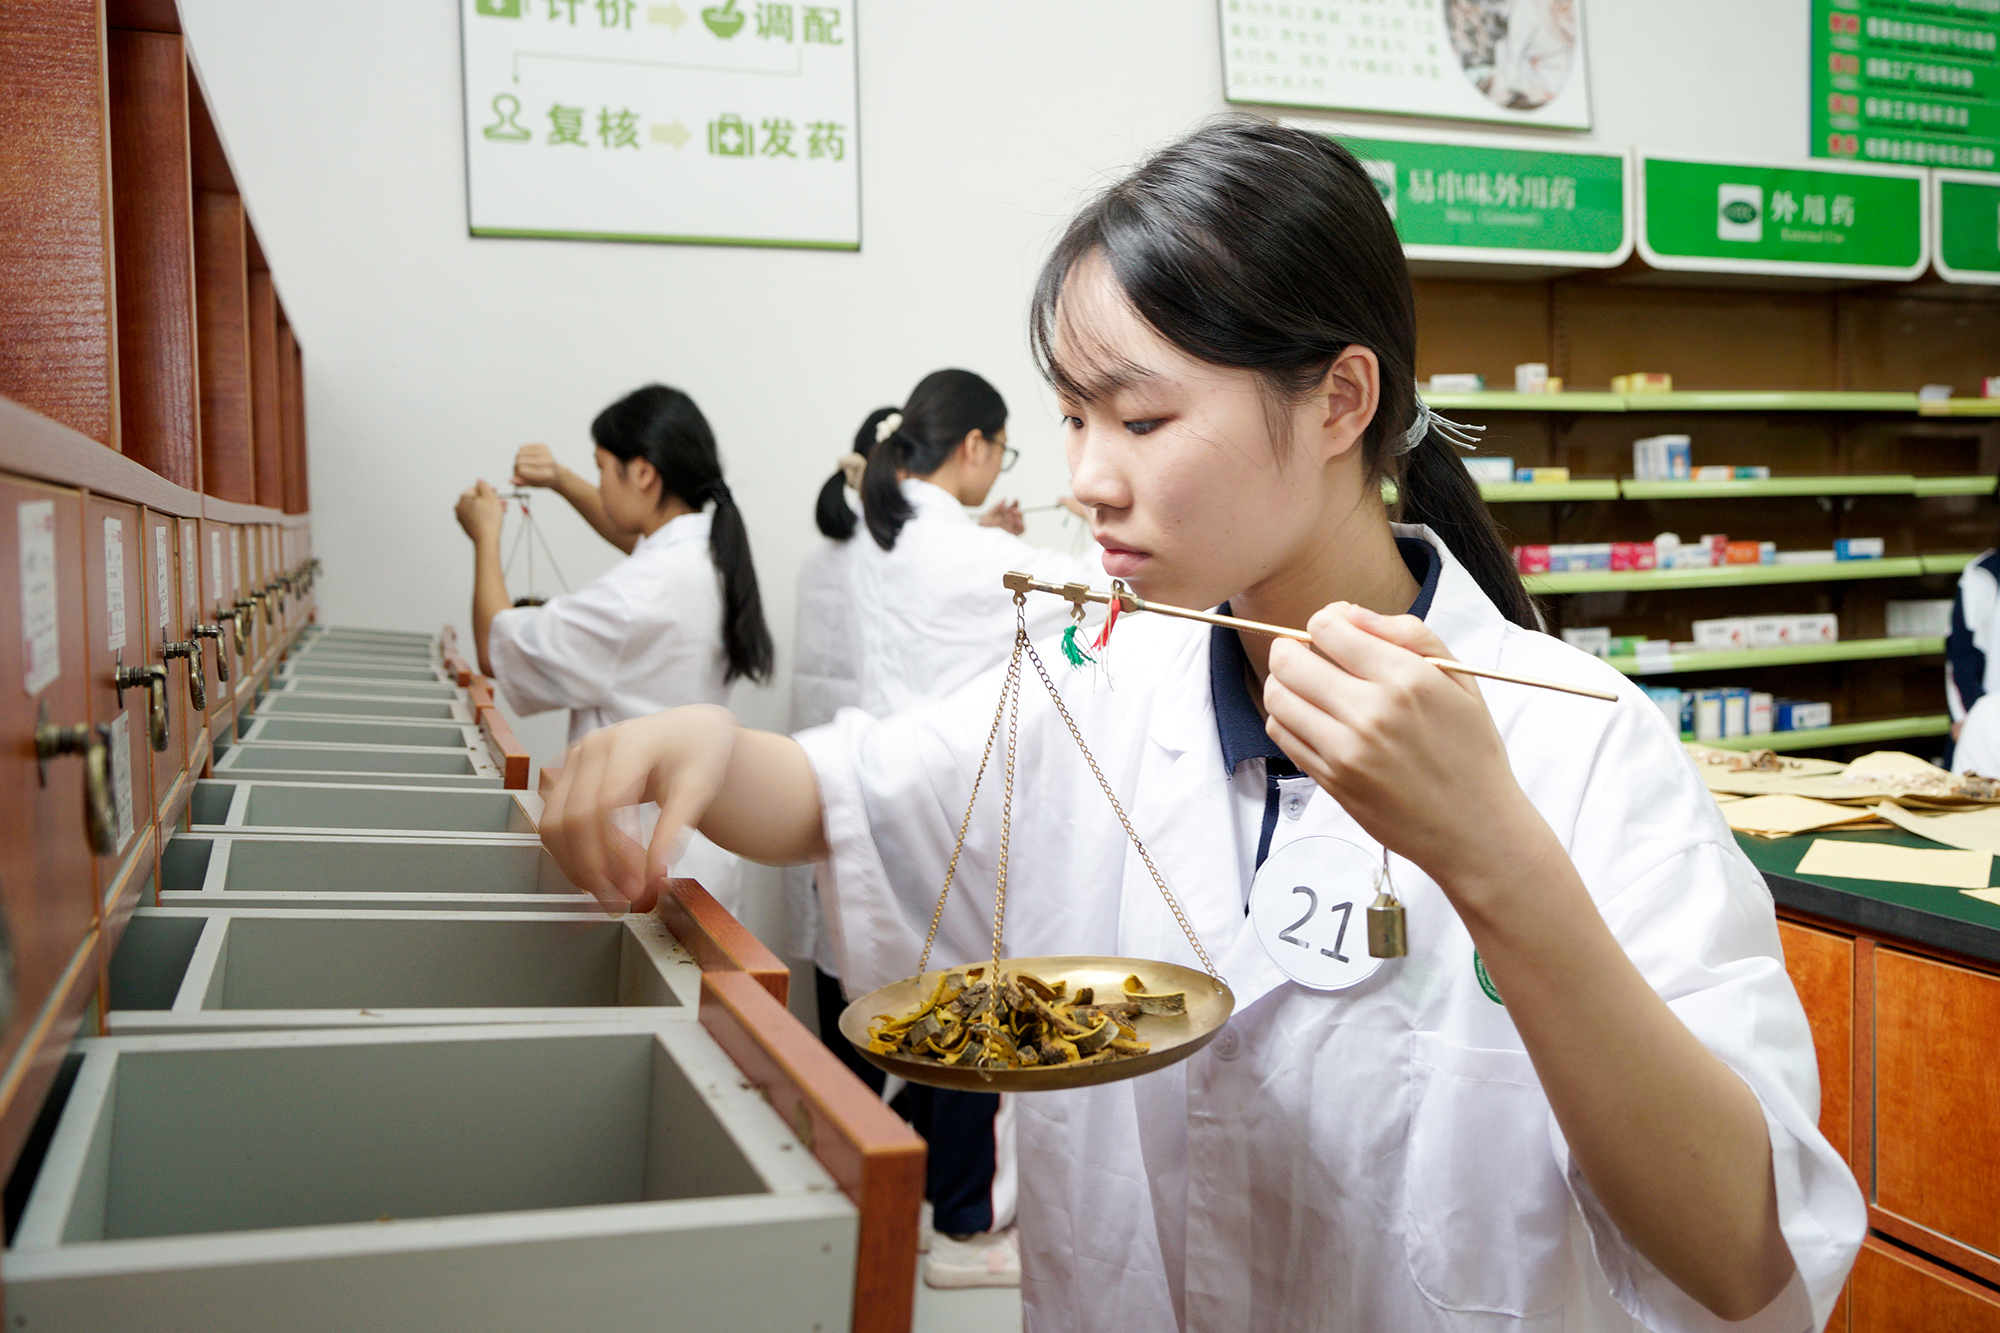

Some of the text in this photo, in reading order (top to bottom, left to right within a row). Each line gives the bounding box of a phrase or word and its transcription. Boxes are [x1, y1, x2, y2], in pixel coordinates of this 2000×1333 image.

[547, 0, 844, 46] 计价 调配
[546, 103, 846, 161] 复核 发药
[1769, 189, 1855, 228] 外用药
[1278, 885, 1354, 964] 21
